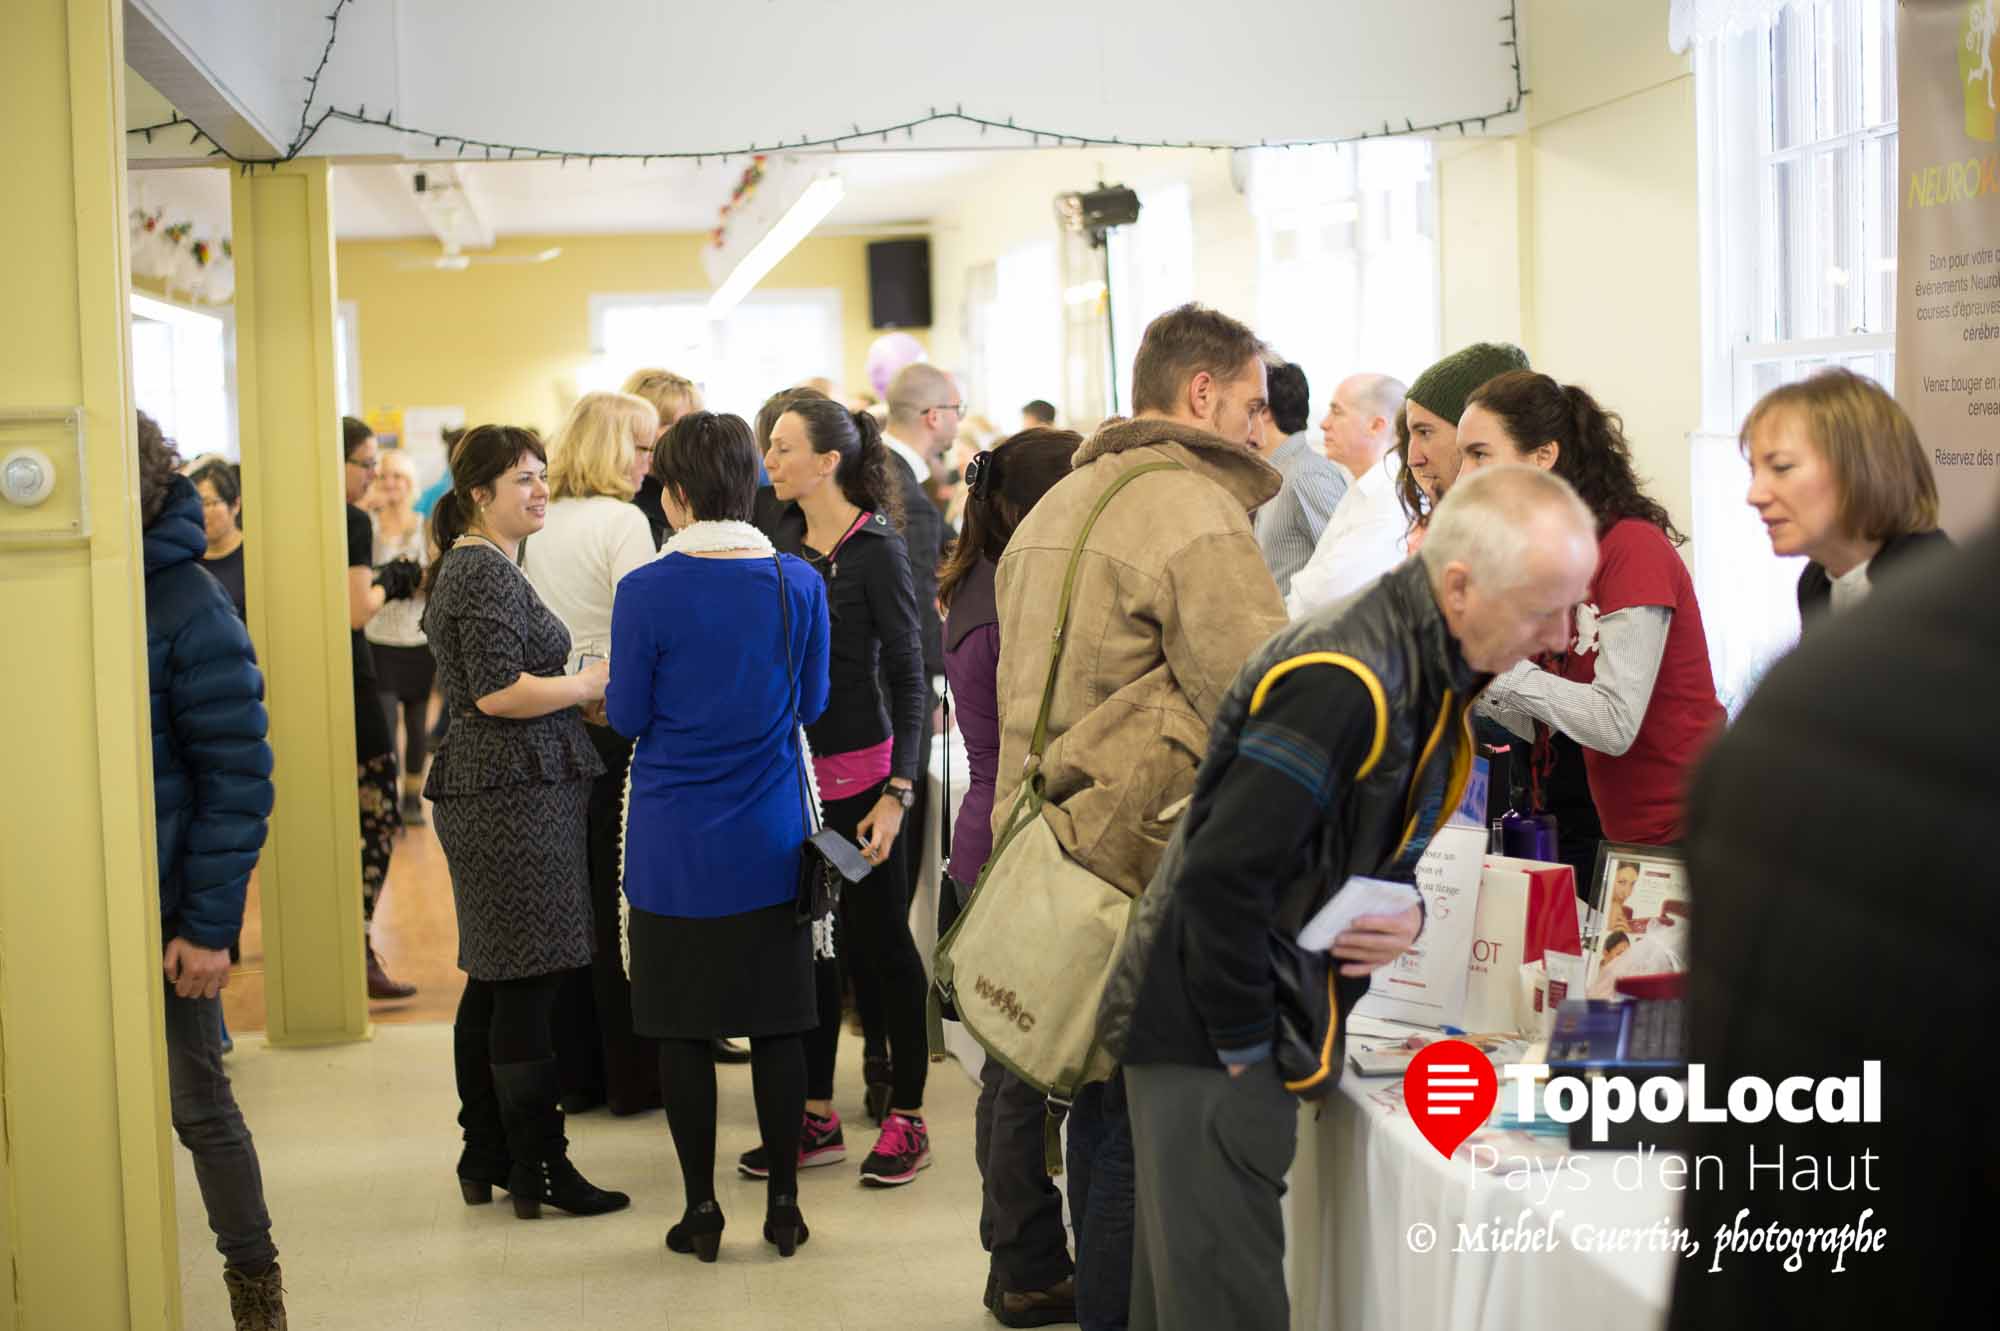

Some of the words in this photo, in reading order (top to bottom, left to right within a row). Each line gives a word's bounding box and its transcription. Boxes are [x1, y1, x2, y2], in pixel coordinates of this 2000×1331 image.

[1929, 254, 1946, 271] Bon
[1949, 252, 1969, 272] pour
[1971, 248, 1993, 265] votre
[1972, 272, 2000, 290] Neuro
[1917, 304, 1951, 320] courses
[1923, 376, 1949, 392] Venez
[1951, 376, 1982, 395] bouger
[1985, 377, 1996, 390] en
[1935, 448, 1975, 465] Réservez
[1977, 448, 1993, 466] dès
